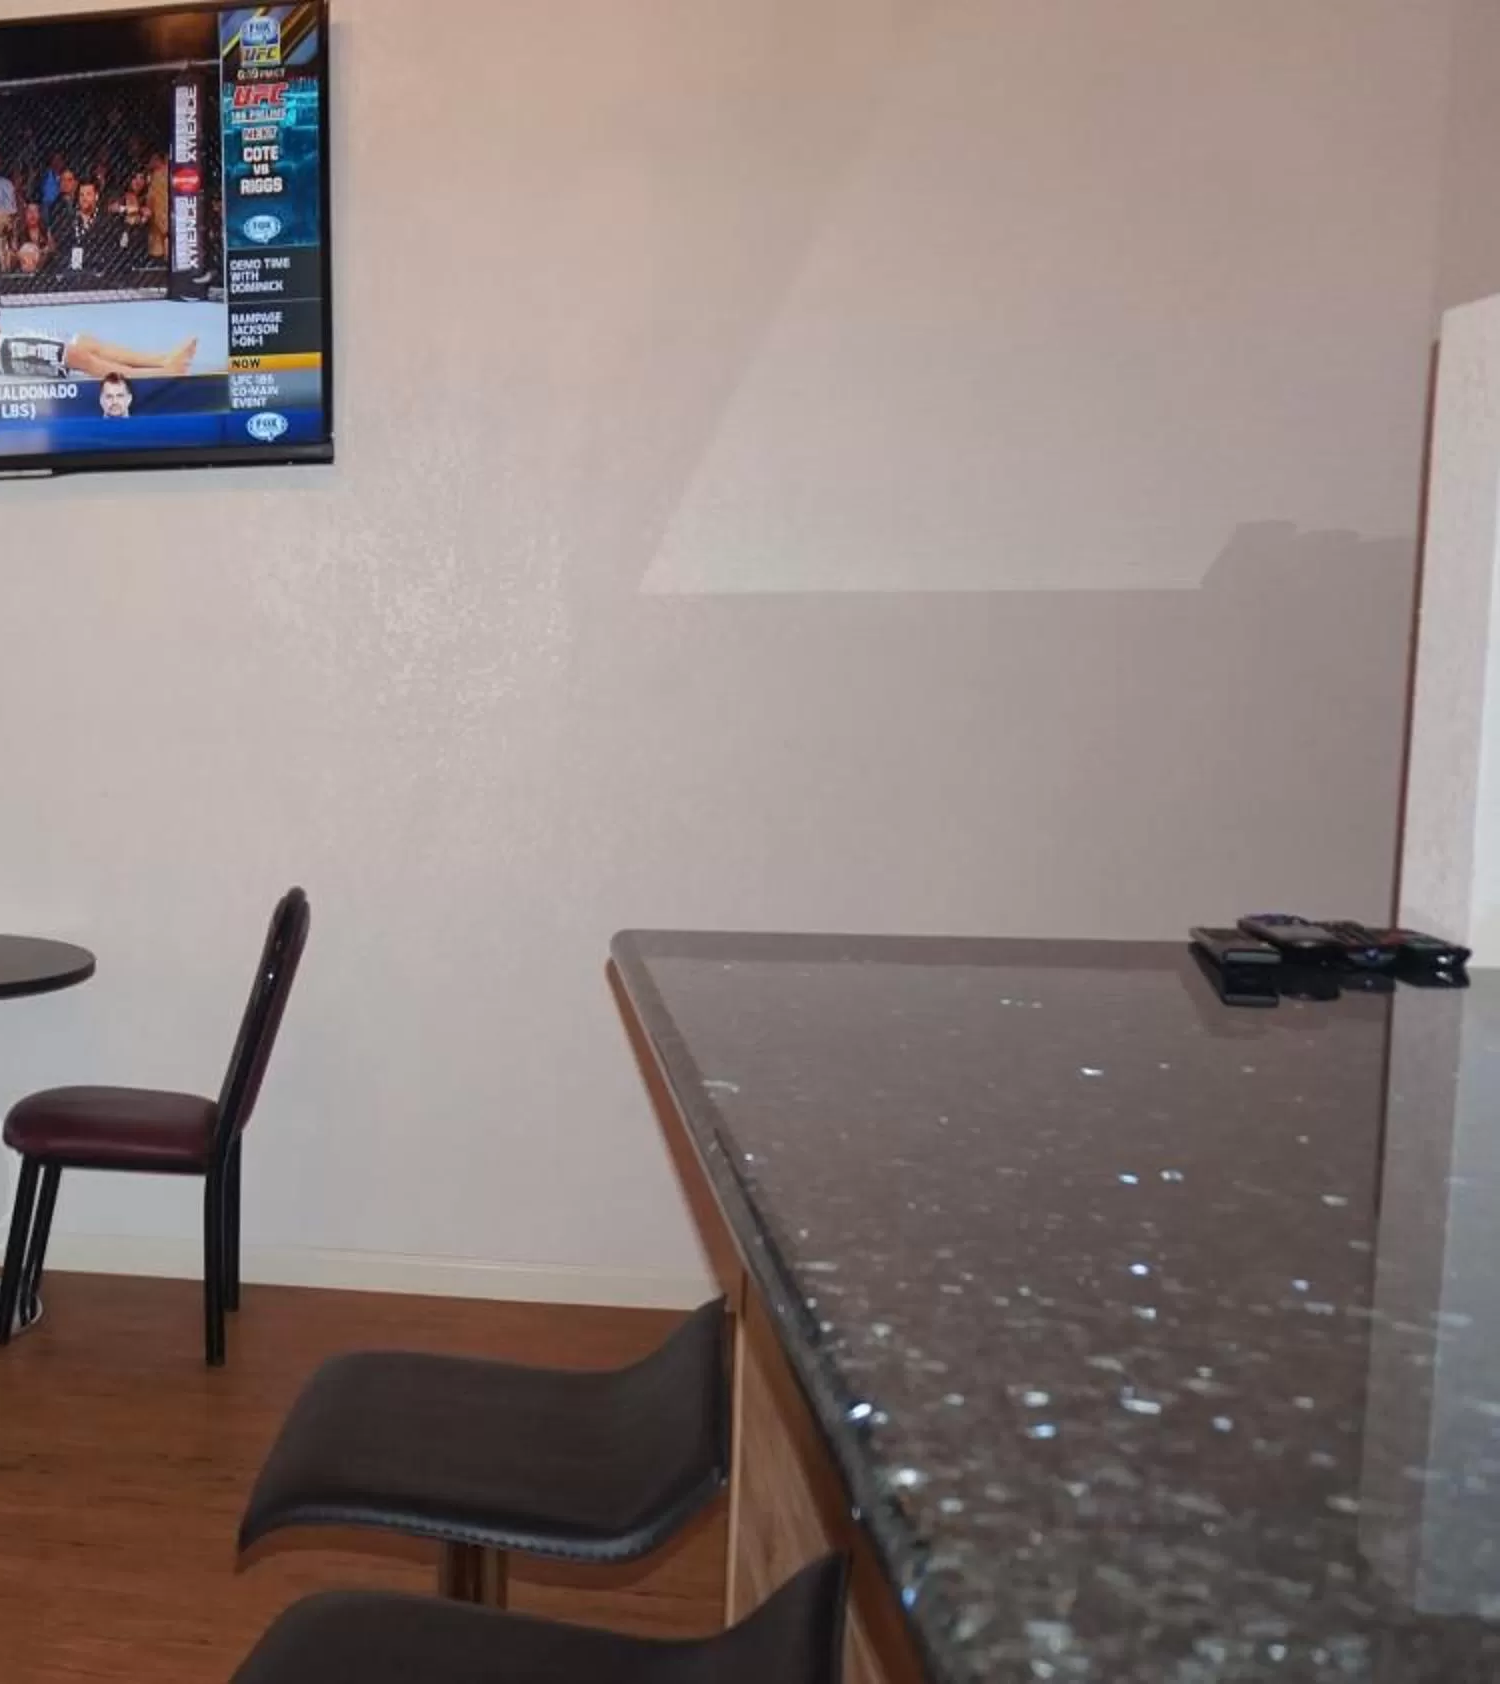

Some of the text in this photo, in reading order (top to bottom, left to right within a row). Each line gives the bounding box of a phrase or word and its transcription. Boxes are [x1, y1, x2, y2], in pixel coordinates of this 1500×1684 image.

[234, 82, 288, 109] UFC
[243, 145, 279, 162] COTE
[240, 177, 283, 195] RIGGS
[264, 257, 291, 269] TIME
[230, 271, 260, 282] WITH
[231, 311, 284, 325] RAMPAGE
[232, 323, 280, 336] JACKSON
[231, 358, 260, 369] NOW
[232, 398, 268, 409] EVENT
[1, 403, 37, 420] LBS)
